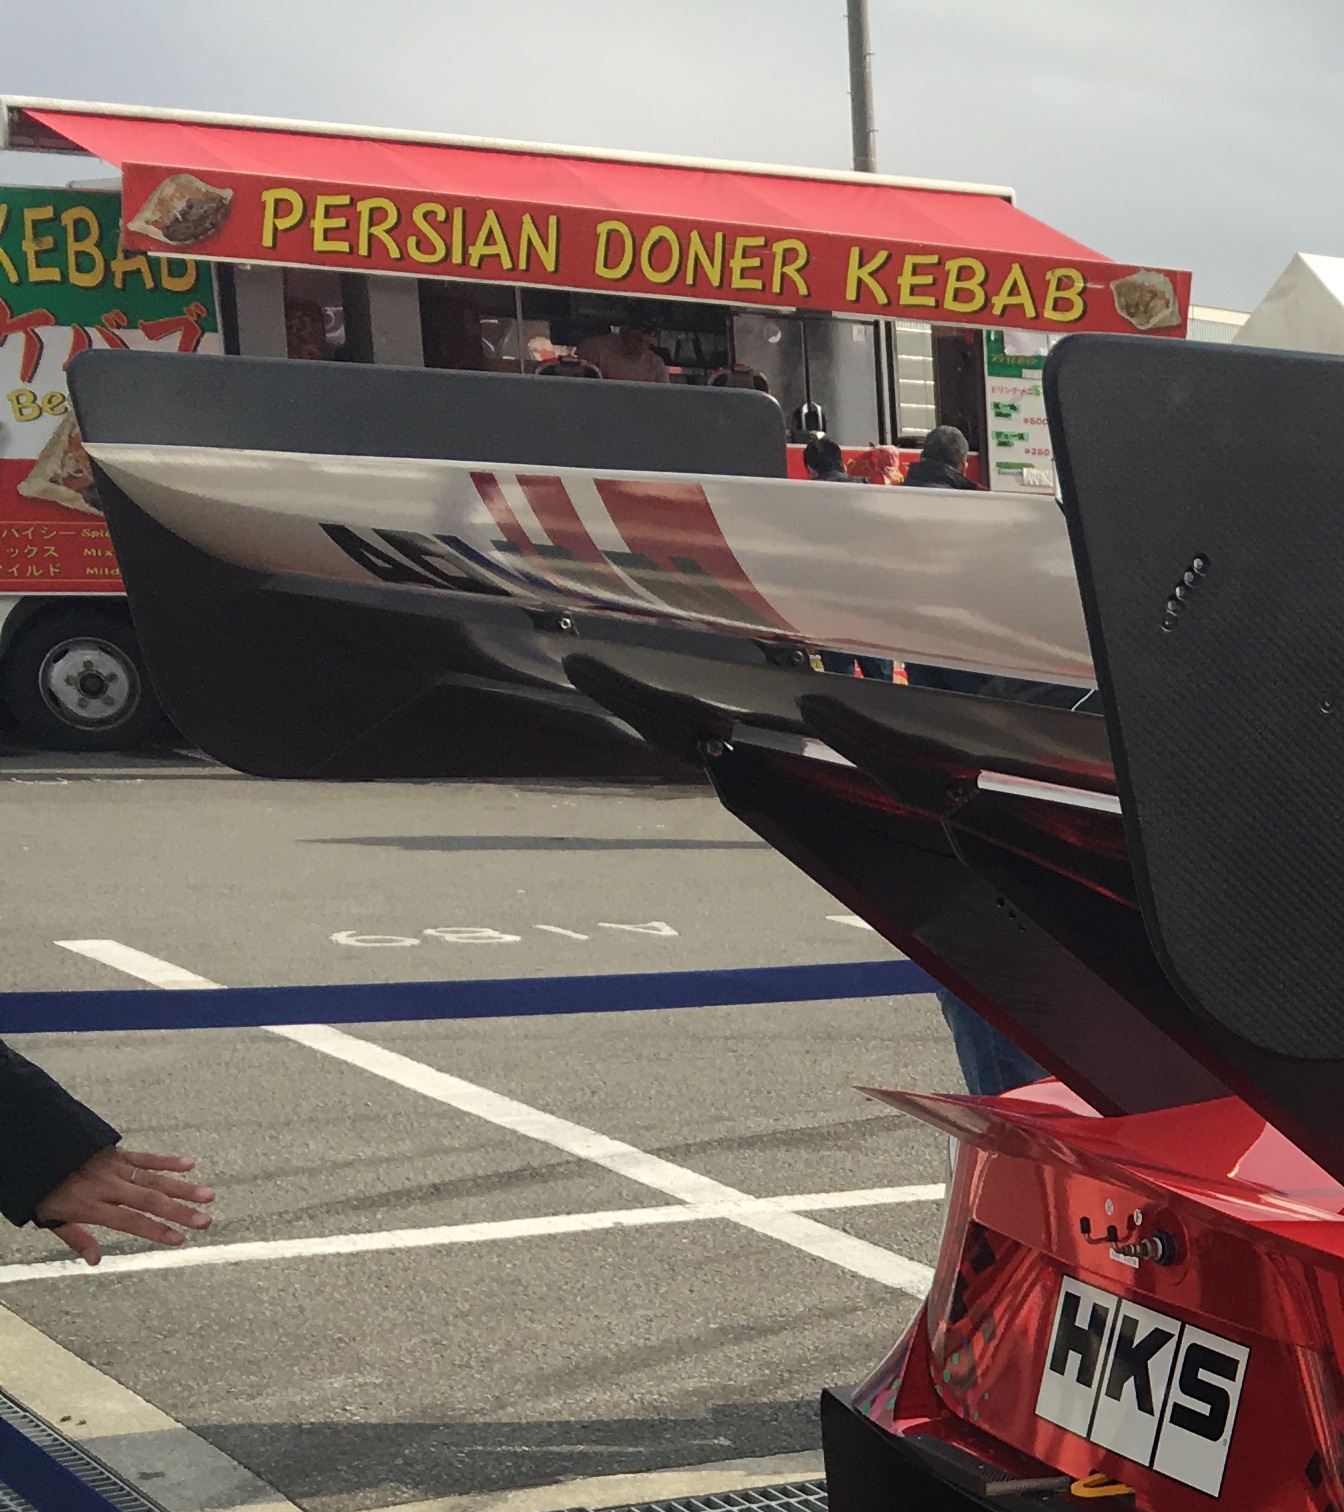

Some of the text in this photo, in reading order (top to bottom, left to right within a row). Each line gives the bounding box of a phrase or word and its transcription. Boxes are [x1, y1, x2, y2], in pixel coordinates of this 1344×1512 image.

[262, 187, 1089, 323] PERSIAN DONER KEBAB
[0, 562, 61, 577] イルド
[1049, 1290, 1241, 1442] HKS
